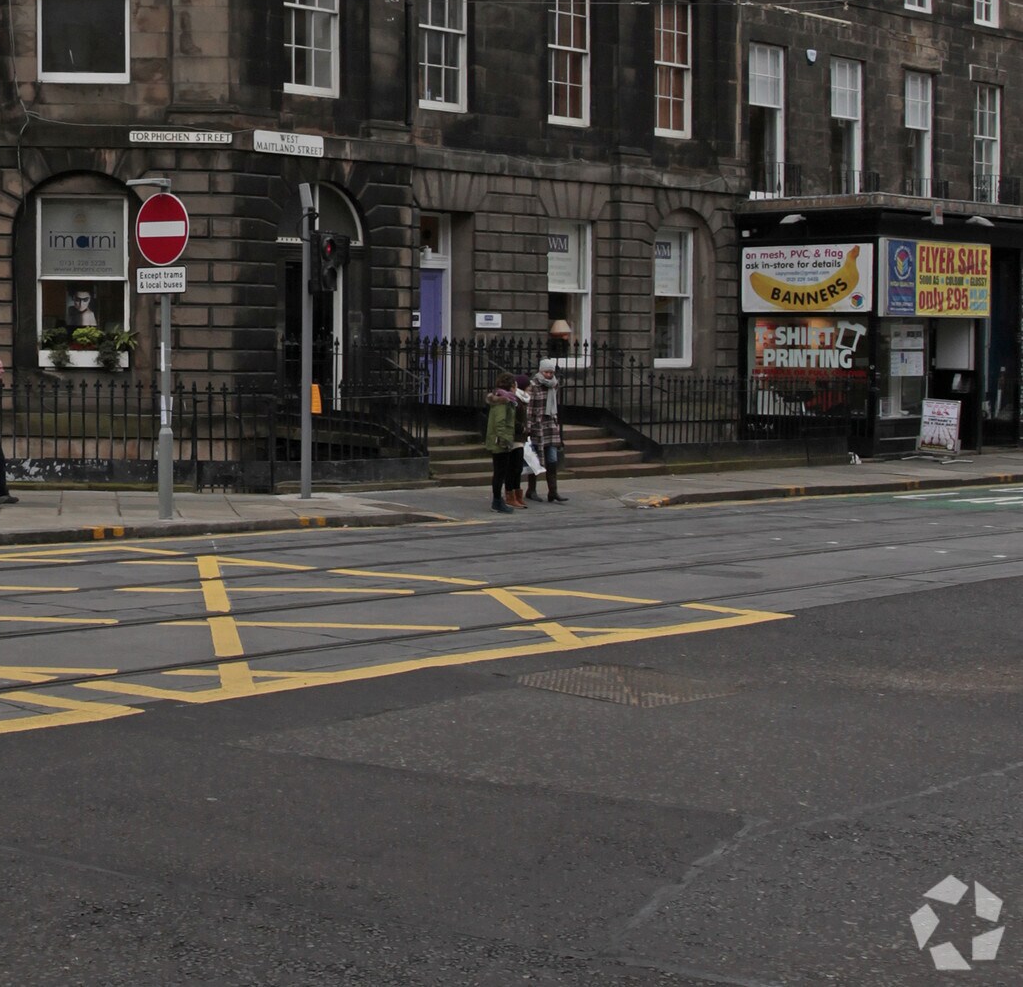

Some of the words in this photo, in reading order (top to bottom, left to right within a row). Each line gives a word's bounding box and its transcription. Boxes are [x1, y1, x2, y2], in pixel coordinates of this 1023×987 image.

[131, 132, 190, 142] TORPHICHEN
[196, 132, 232, 142] STREET
[280, 134, 298, 143] WEST
[256, 141, 296, 154] MAITLAND
[298, 145, 323, 156] STREET
[49, 231, 116, 248] imarni
[760, 250, 787, 260] mesh,
[790, 250, 810, 259] PVC,
[814, 250, 821, 258] &
[824, 249, 844, 259] flag
[918, 246, 955, 274] FLYER
[958, 248, 987, 275] SALE
[762, 261, 794, 269] in-store
[812, 260, 841, 268] details
[933, 275, 939, 285] A5
[770, 278, 848, 305] BANNERS
[919, 287, 944, 312] only
[946, 287, 968, 310] £95
[754, 326, 835, 346] T-SHIRT
[763, 349, 852, 369] PRINTING
